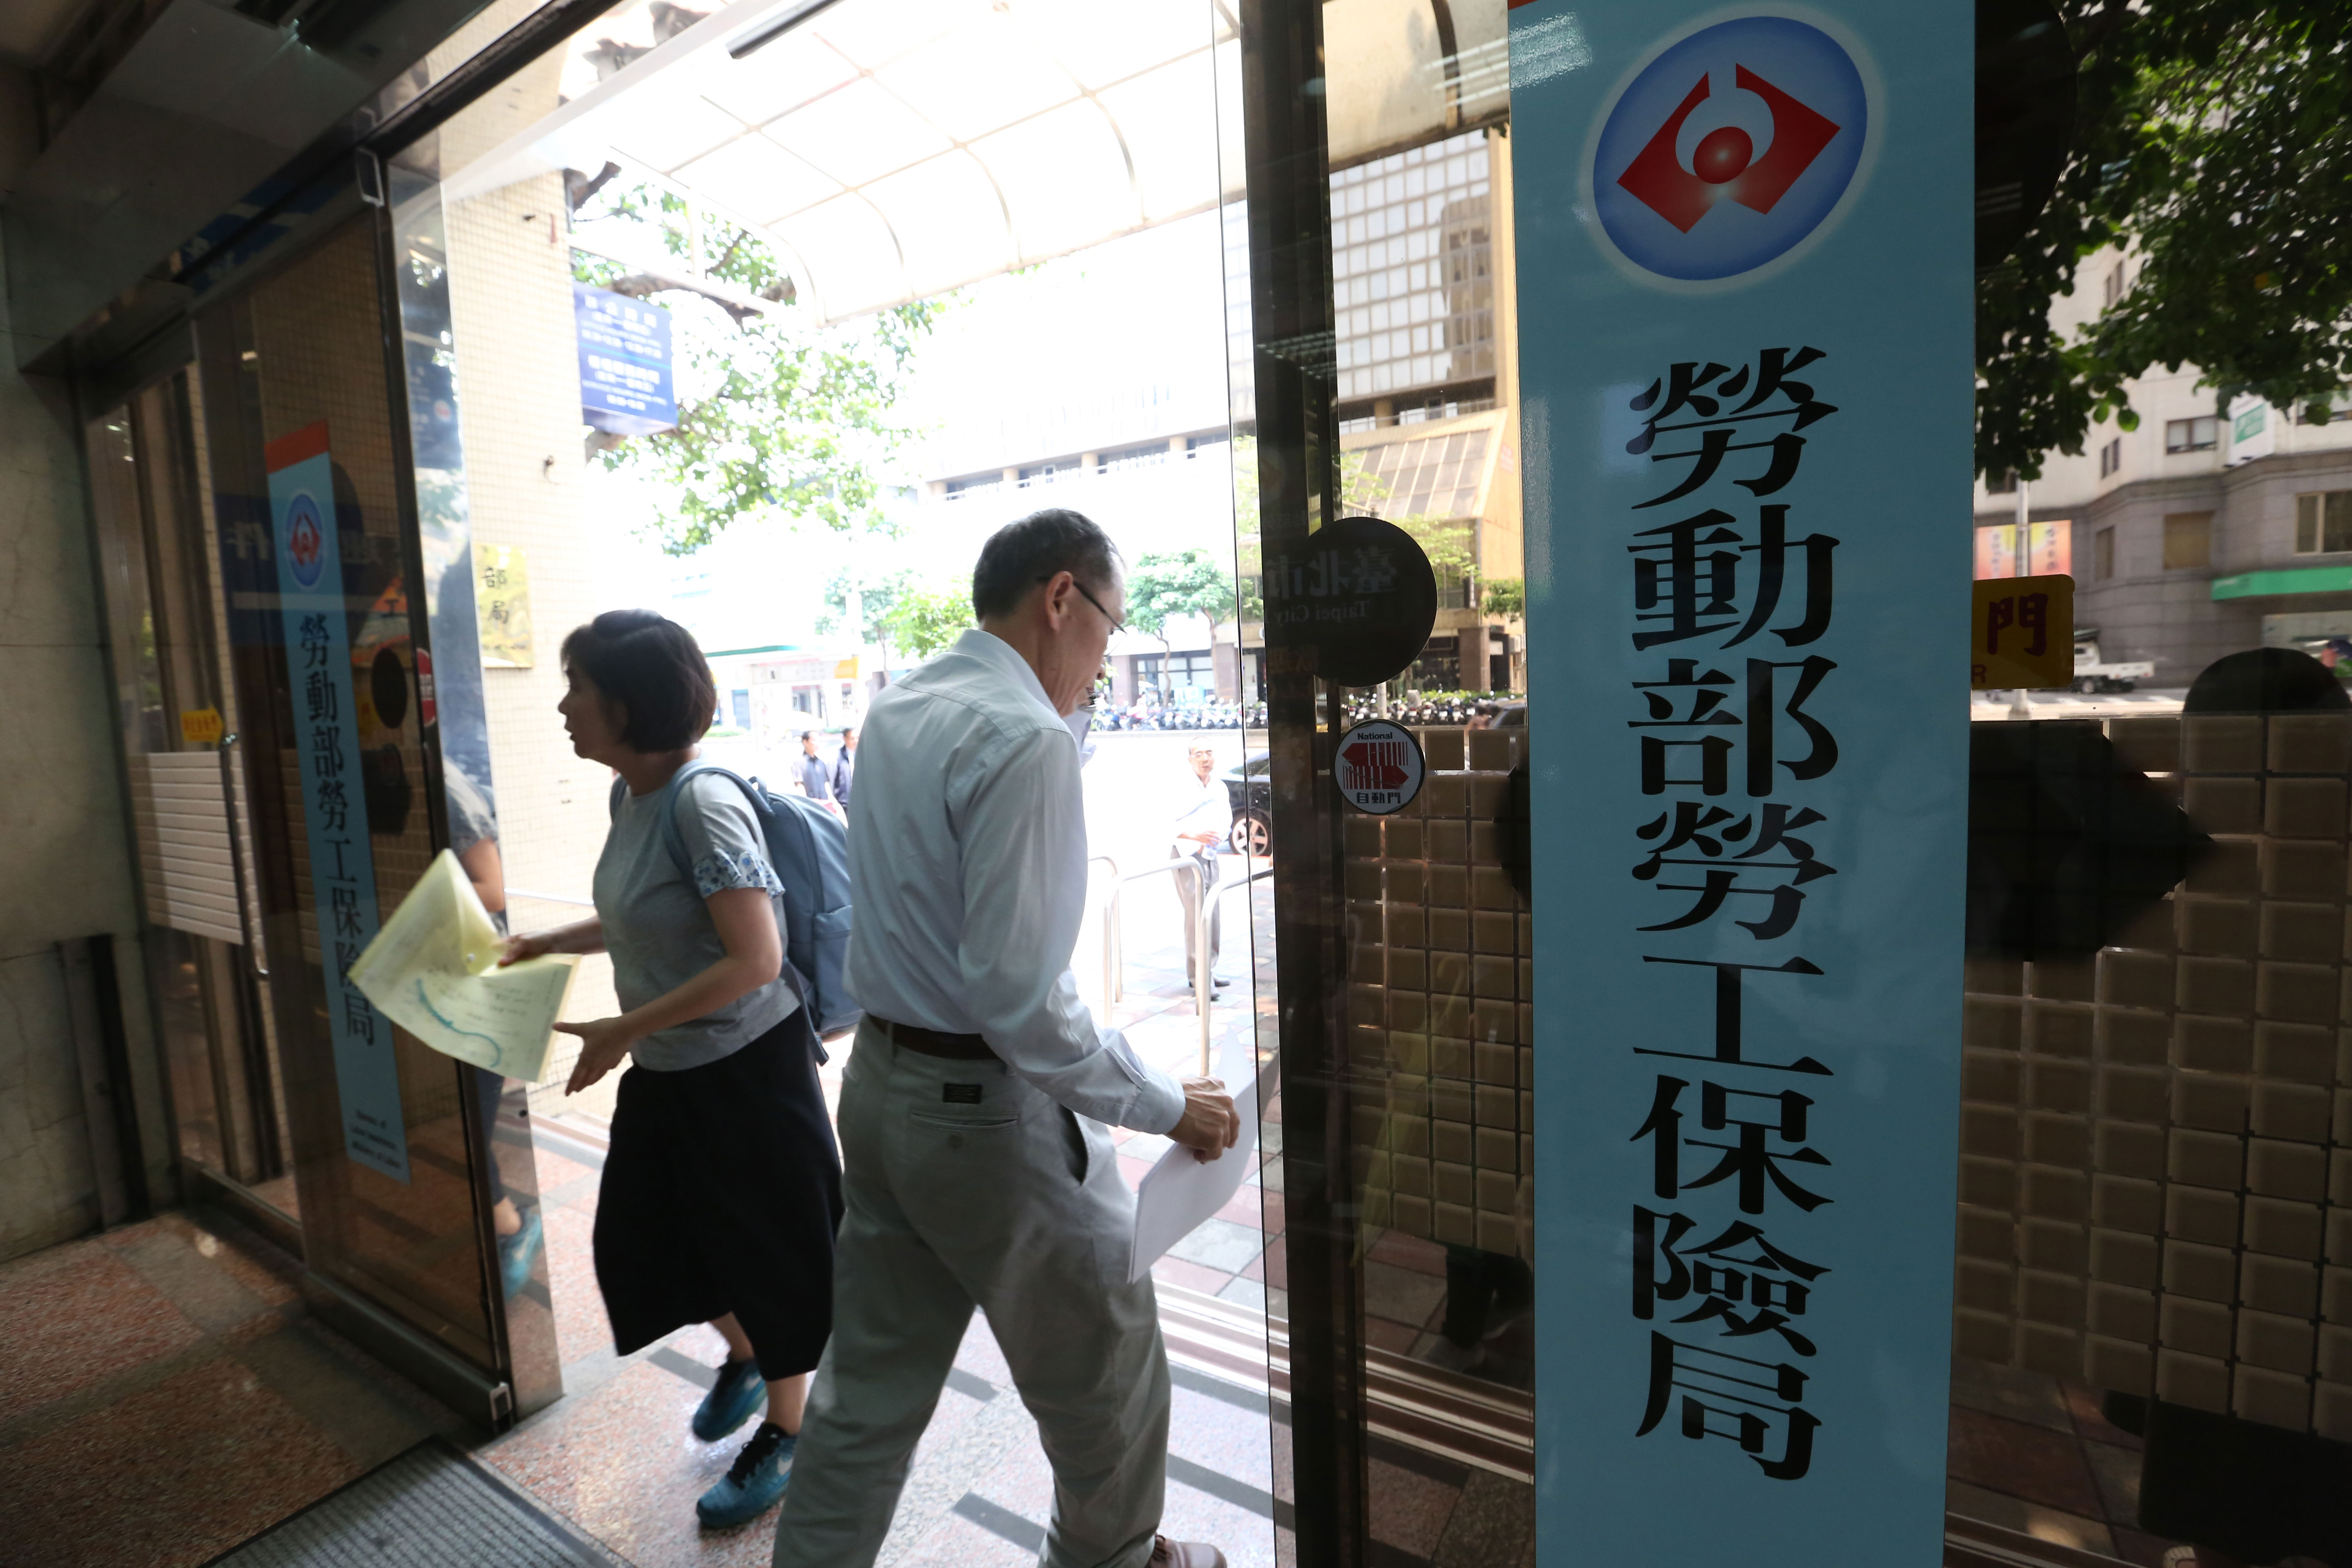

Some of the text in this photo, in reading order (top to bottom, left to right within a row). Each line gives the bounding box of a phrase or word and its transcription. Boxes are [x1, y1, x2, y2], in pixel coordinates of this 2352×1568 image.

[1987, 592, 2048, 656] 門
[1356, 792, 1401, 804] 自動門
[1627, 346, 1840, 1481] 勞動部勞工保險局
